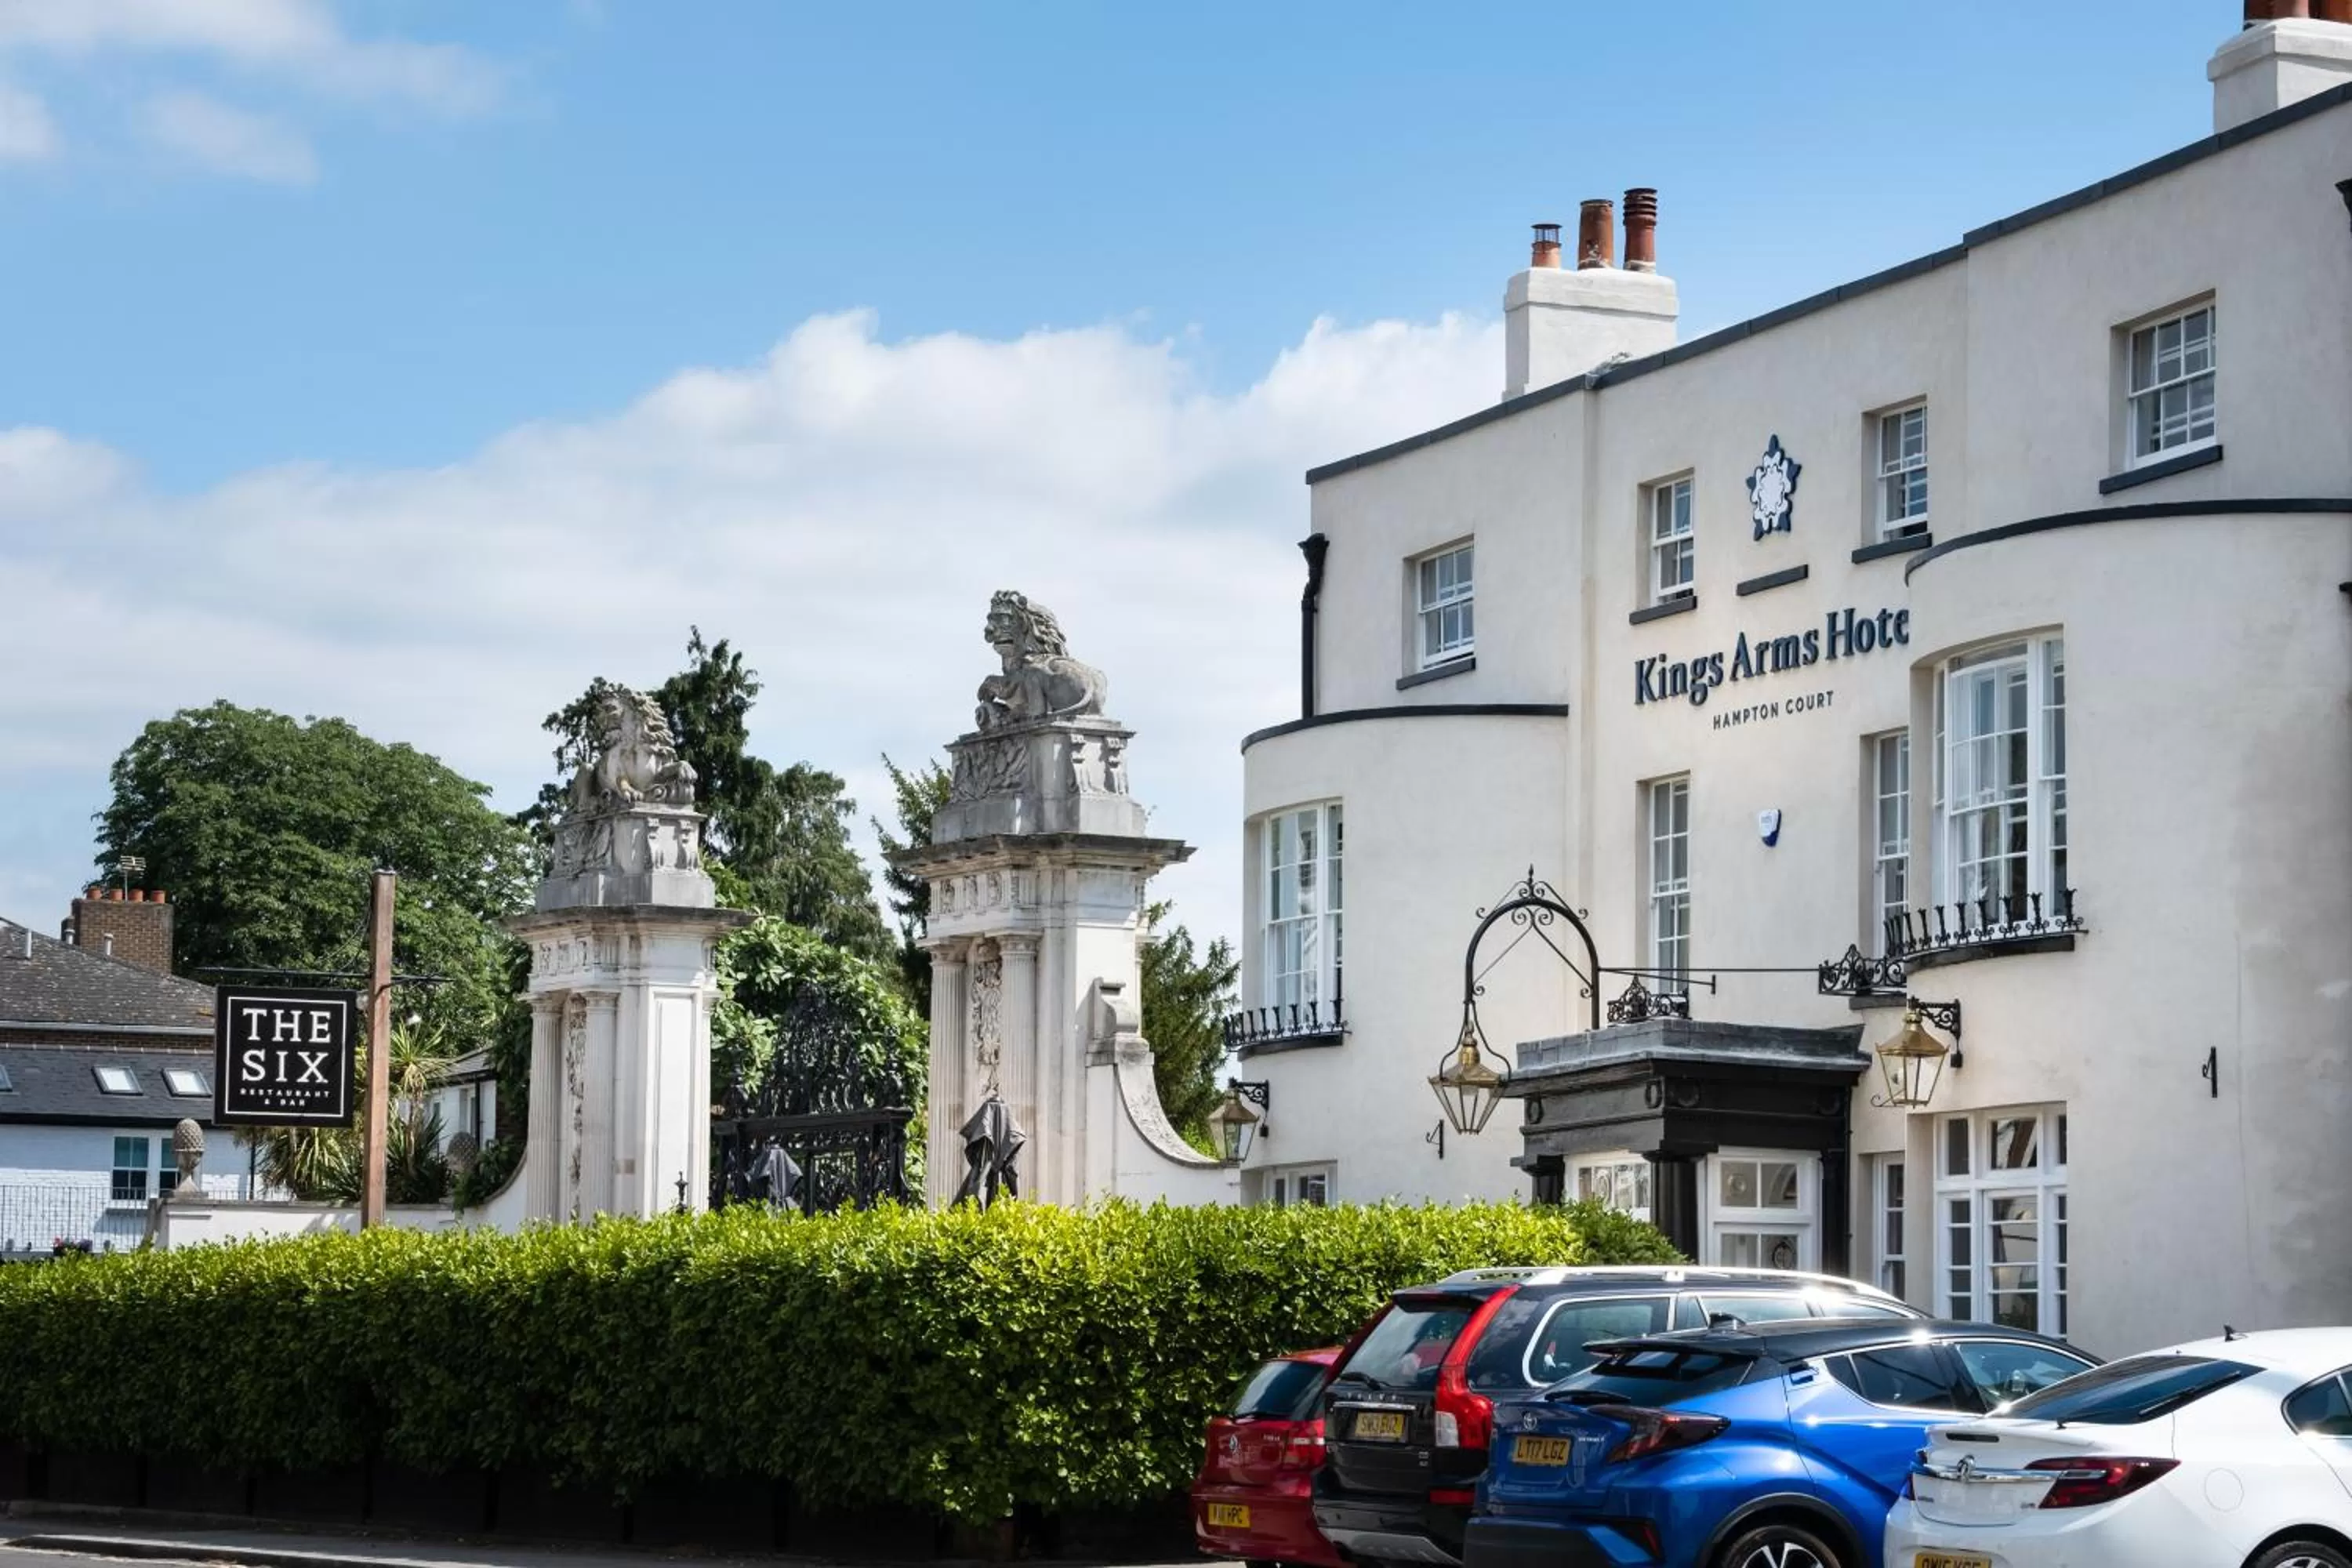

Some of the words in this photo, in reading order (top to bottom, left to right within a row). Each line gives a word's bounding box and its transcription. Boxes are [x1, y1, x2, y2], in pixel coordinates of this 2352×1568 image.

[1634, 652, 1724, 706] Kings
[1730, 630, 1820, 682] Arms
[1824, 608, 1909, 661] Hote
[1713, 702, 1779, 730] HAMPTON
[1785, 690, 1834, 715] COURT
[242, 1007, 331, 1044] THE
[241, 1048, 329, 1083] SIX
